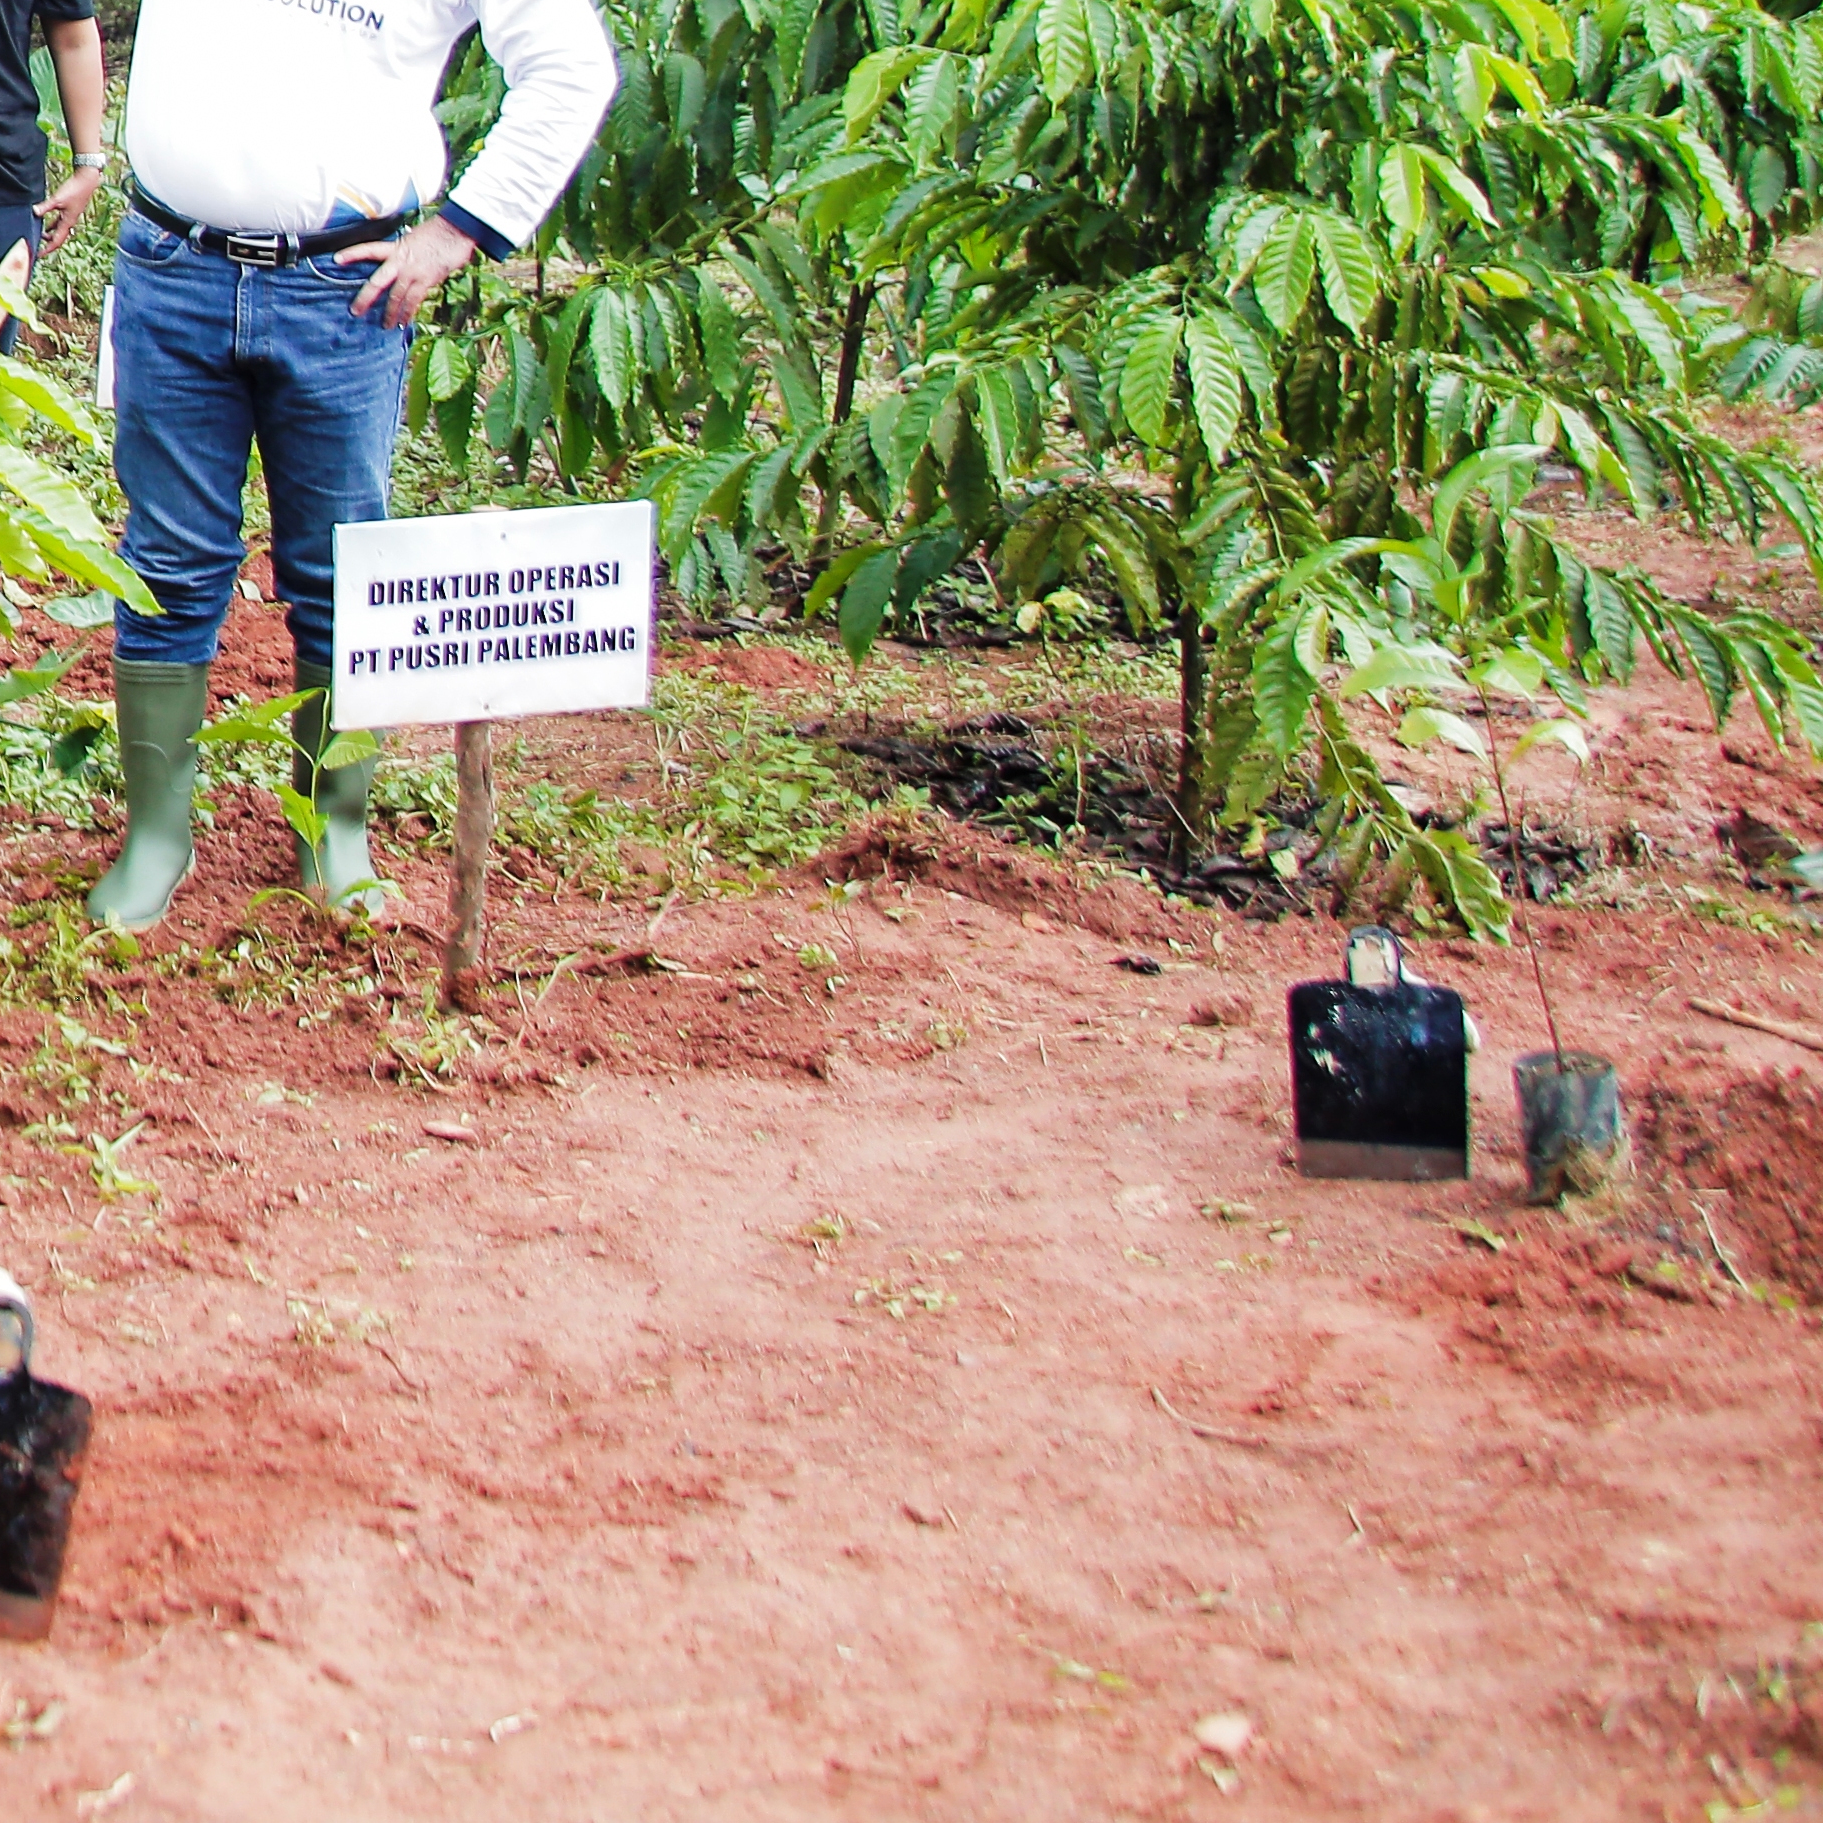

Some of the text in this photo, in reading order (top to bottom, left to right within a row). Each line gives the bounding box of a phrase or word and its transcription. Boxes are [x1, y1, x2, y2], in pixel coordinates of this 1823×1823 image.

[367, 560, 621, 607] DIREKTUR OPERASI
[413, 598, 575, 636] & PRODUKSI
[348, 625, 636, 675] PT PUSRI PALEMBANG
